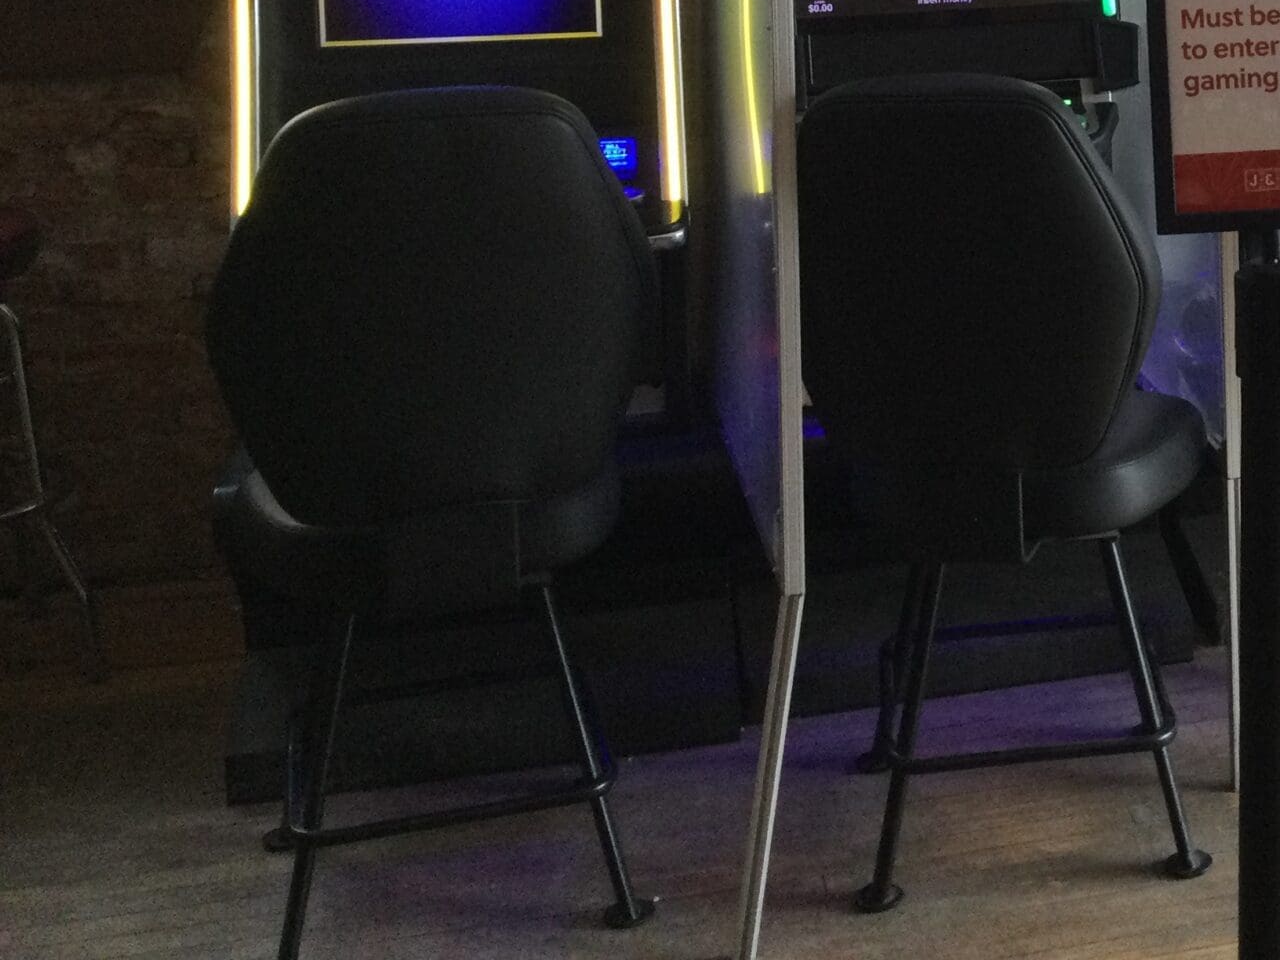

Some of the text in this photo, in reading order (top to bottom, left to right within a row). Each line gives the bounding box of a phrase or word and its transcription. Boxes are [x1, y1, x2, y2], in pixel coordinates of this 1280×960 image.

[1180, 7, 1244, 30] Must
[1181, 41, 1208, 61] to
[1213, 36, 1280, 59] enter
[1183, 68, 1280, 98] gaming
